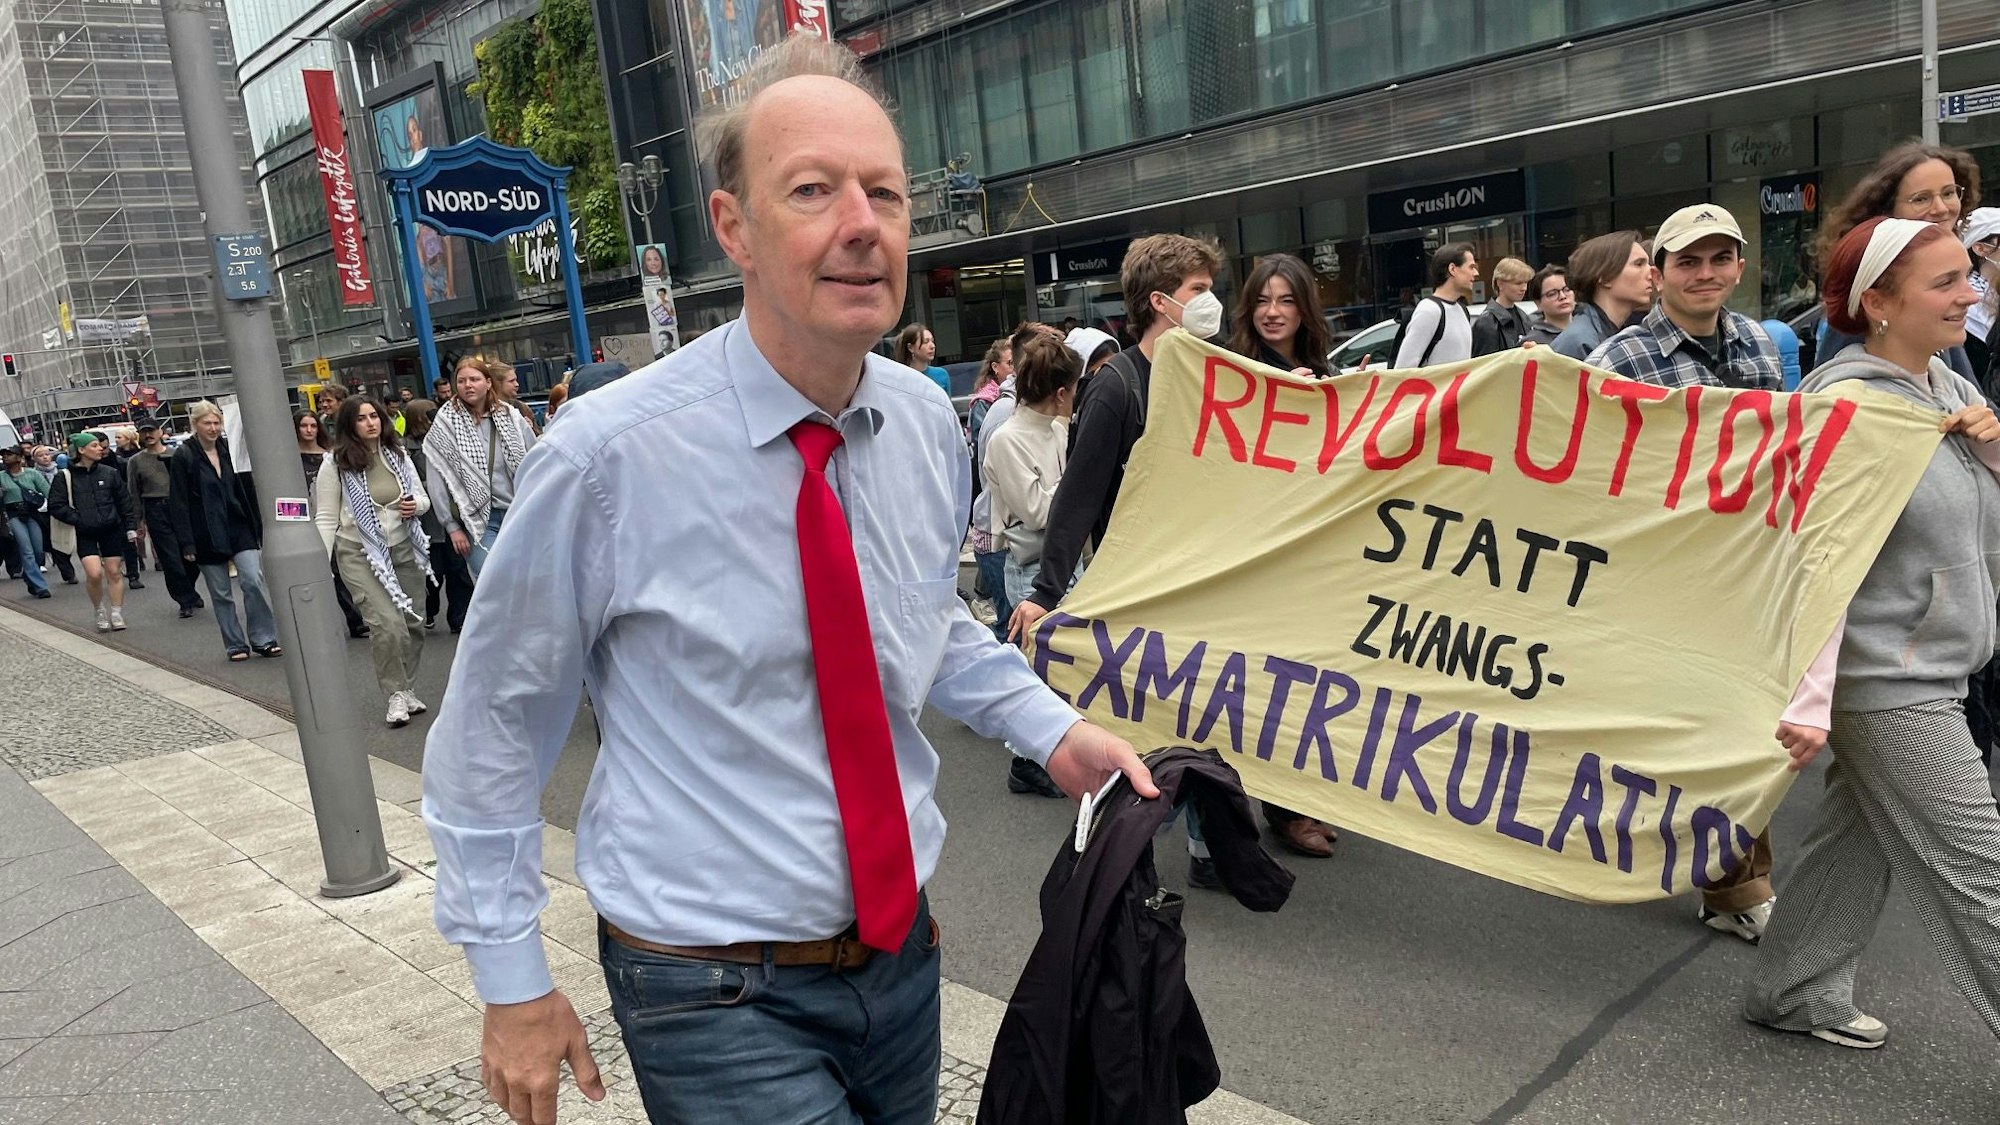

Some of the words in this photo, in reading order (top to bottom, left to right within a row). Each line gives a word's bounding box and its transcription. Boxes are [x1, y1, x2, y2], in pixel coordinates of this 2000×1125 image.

[694, 67, 720, 93] The
[425, 186, 541, 212] NORD-SÜD
[1403, 185, 1486, 217] CrushON
[227, 243, 241, 257] S
[242, 246, 262, 257] 200
[1192, 355, 1857, 534] REVOLUTION
[1363, 498, 1609, 608] STATT
[1350, 594, 1565, 700] ZWANGS-
